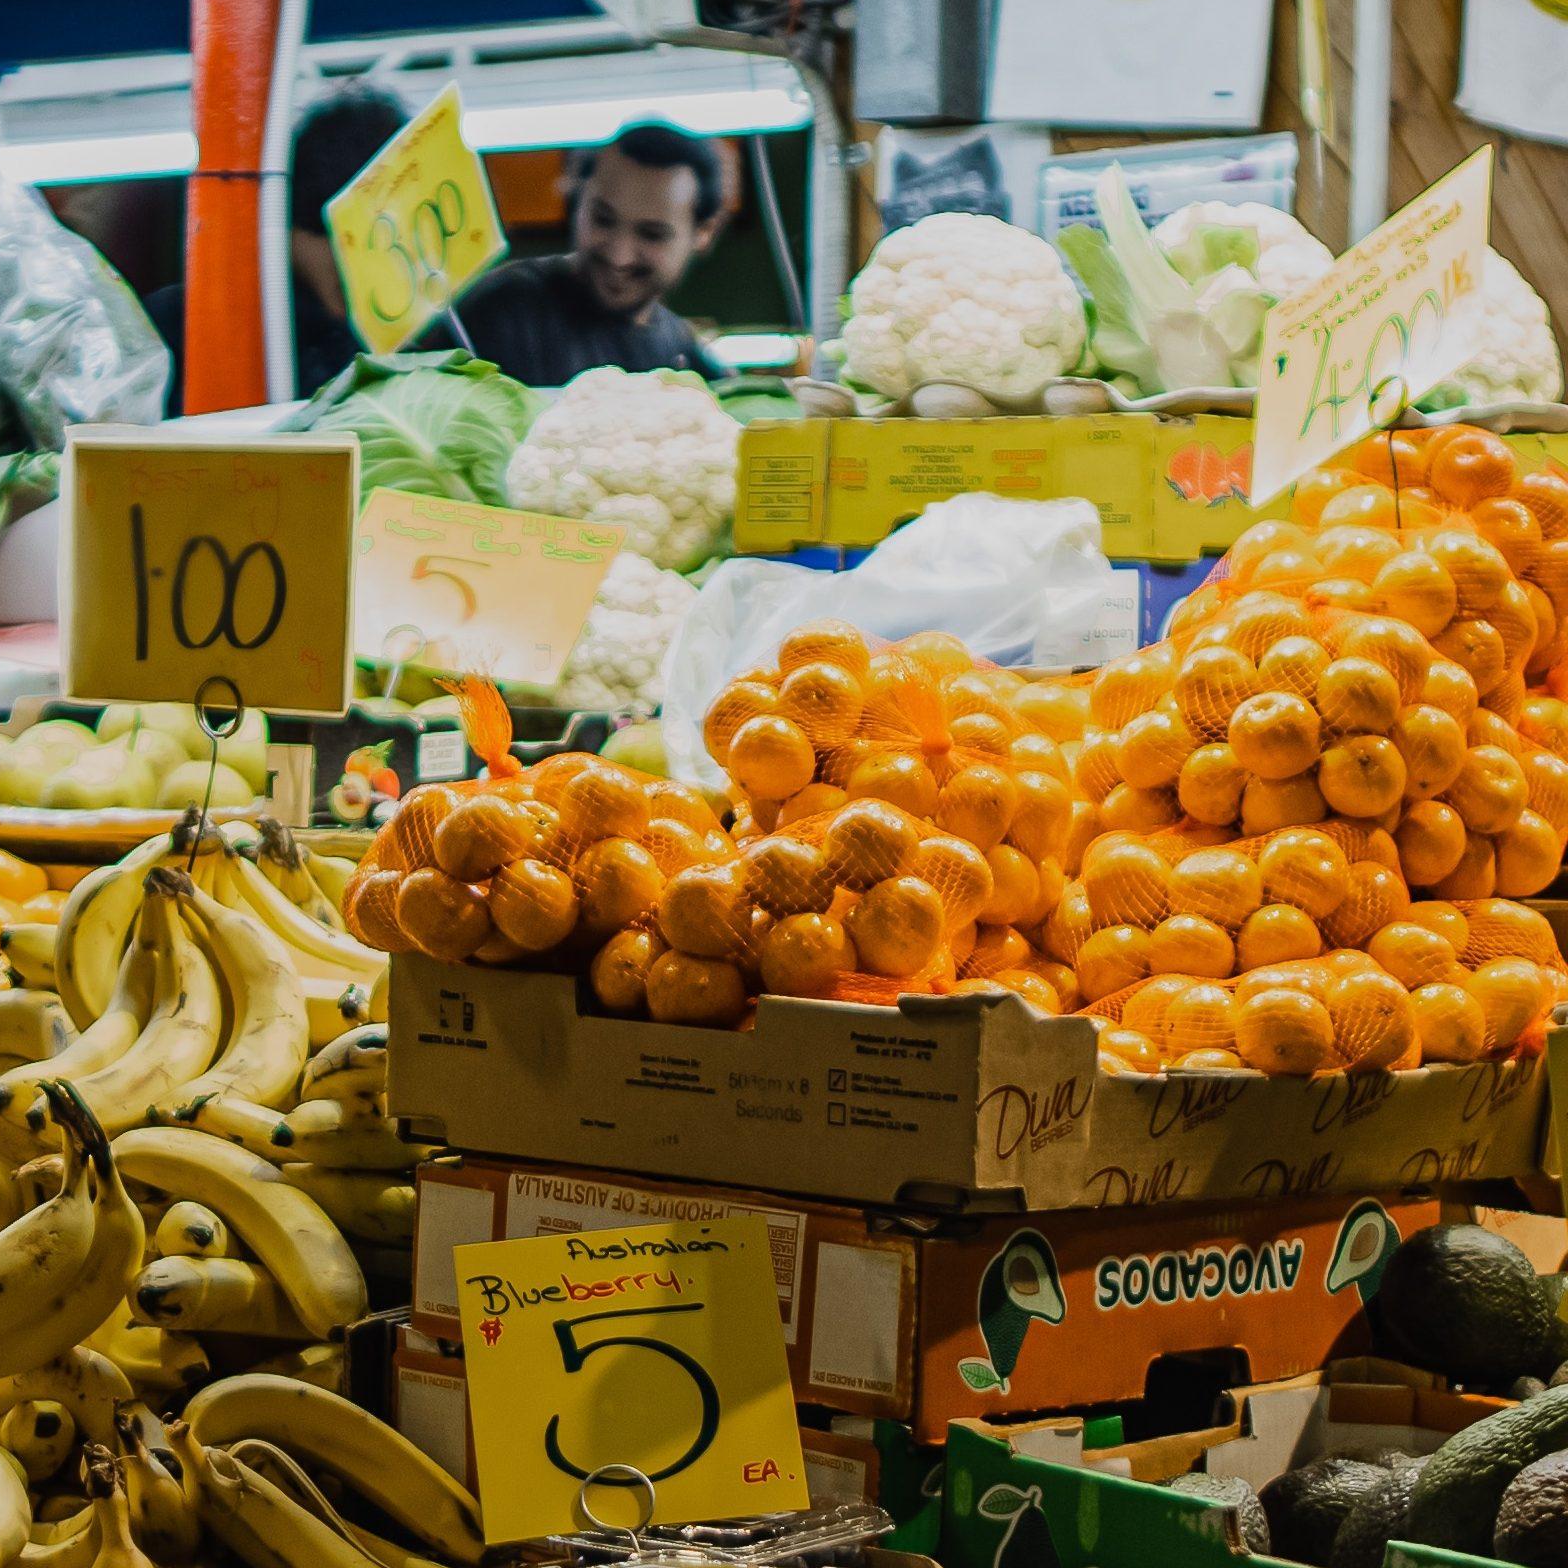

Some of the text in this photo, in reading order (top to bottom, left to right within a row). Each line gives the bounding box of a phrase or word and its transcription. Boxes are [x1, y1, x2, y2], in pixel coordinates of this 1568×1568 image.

[130, 502, 287, 662] 1.00
[735, 1098, 804, 1124] Seconds
[978, 1077, 1096, 1159] Diva
[1030, 1122, 1076, 1154] BERRIES
[513, 1174, 610, 1209] AUSTRALIA
[611, 1191, 635, 1213] OF
[567, 1228, 730, 1261] Australian
[1094, 1238, 1304, 1311] AVOCADOS
[544, 1302, 721, 1487] 5
